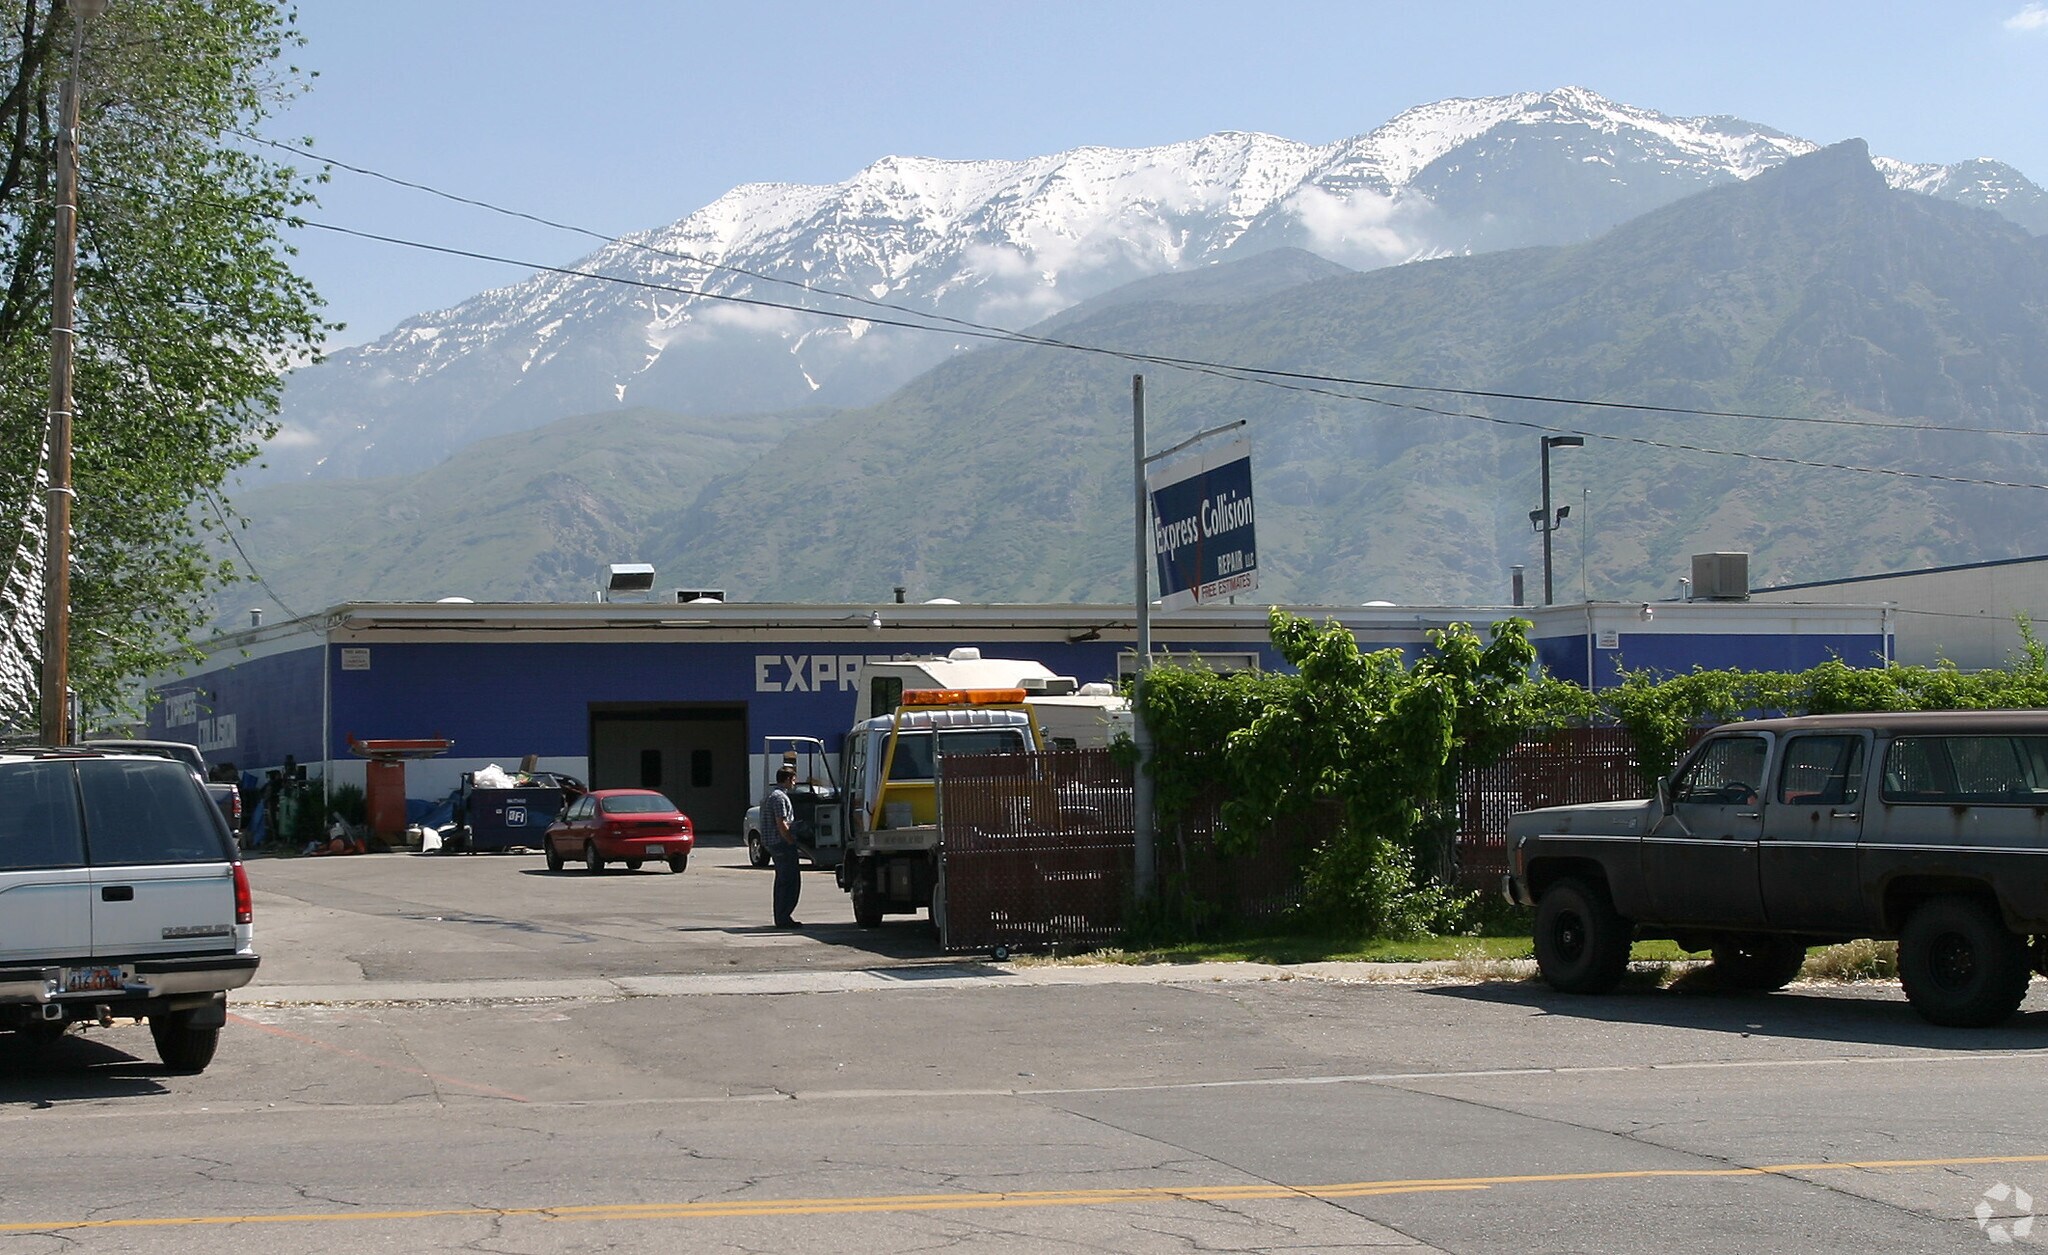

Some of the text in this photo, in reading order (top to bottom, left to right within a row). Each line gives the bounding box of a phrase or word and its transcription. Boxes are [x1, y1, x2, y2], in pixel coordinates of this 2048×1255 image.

[1155, 489, 1253, 561] Express Collision
[1217, 550, 1243, 576] REPAIR
[1201, 572, 1251, 599] FREE ESTIMATES
[508, 810, 525, 823] BFI
